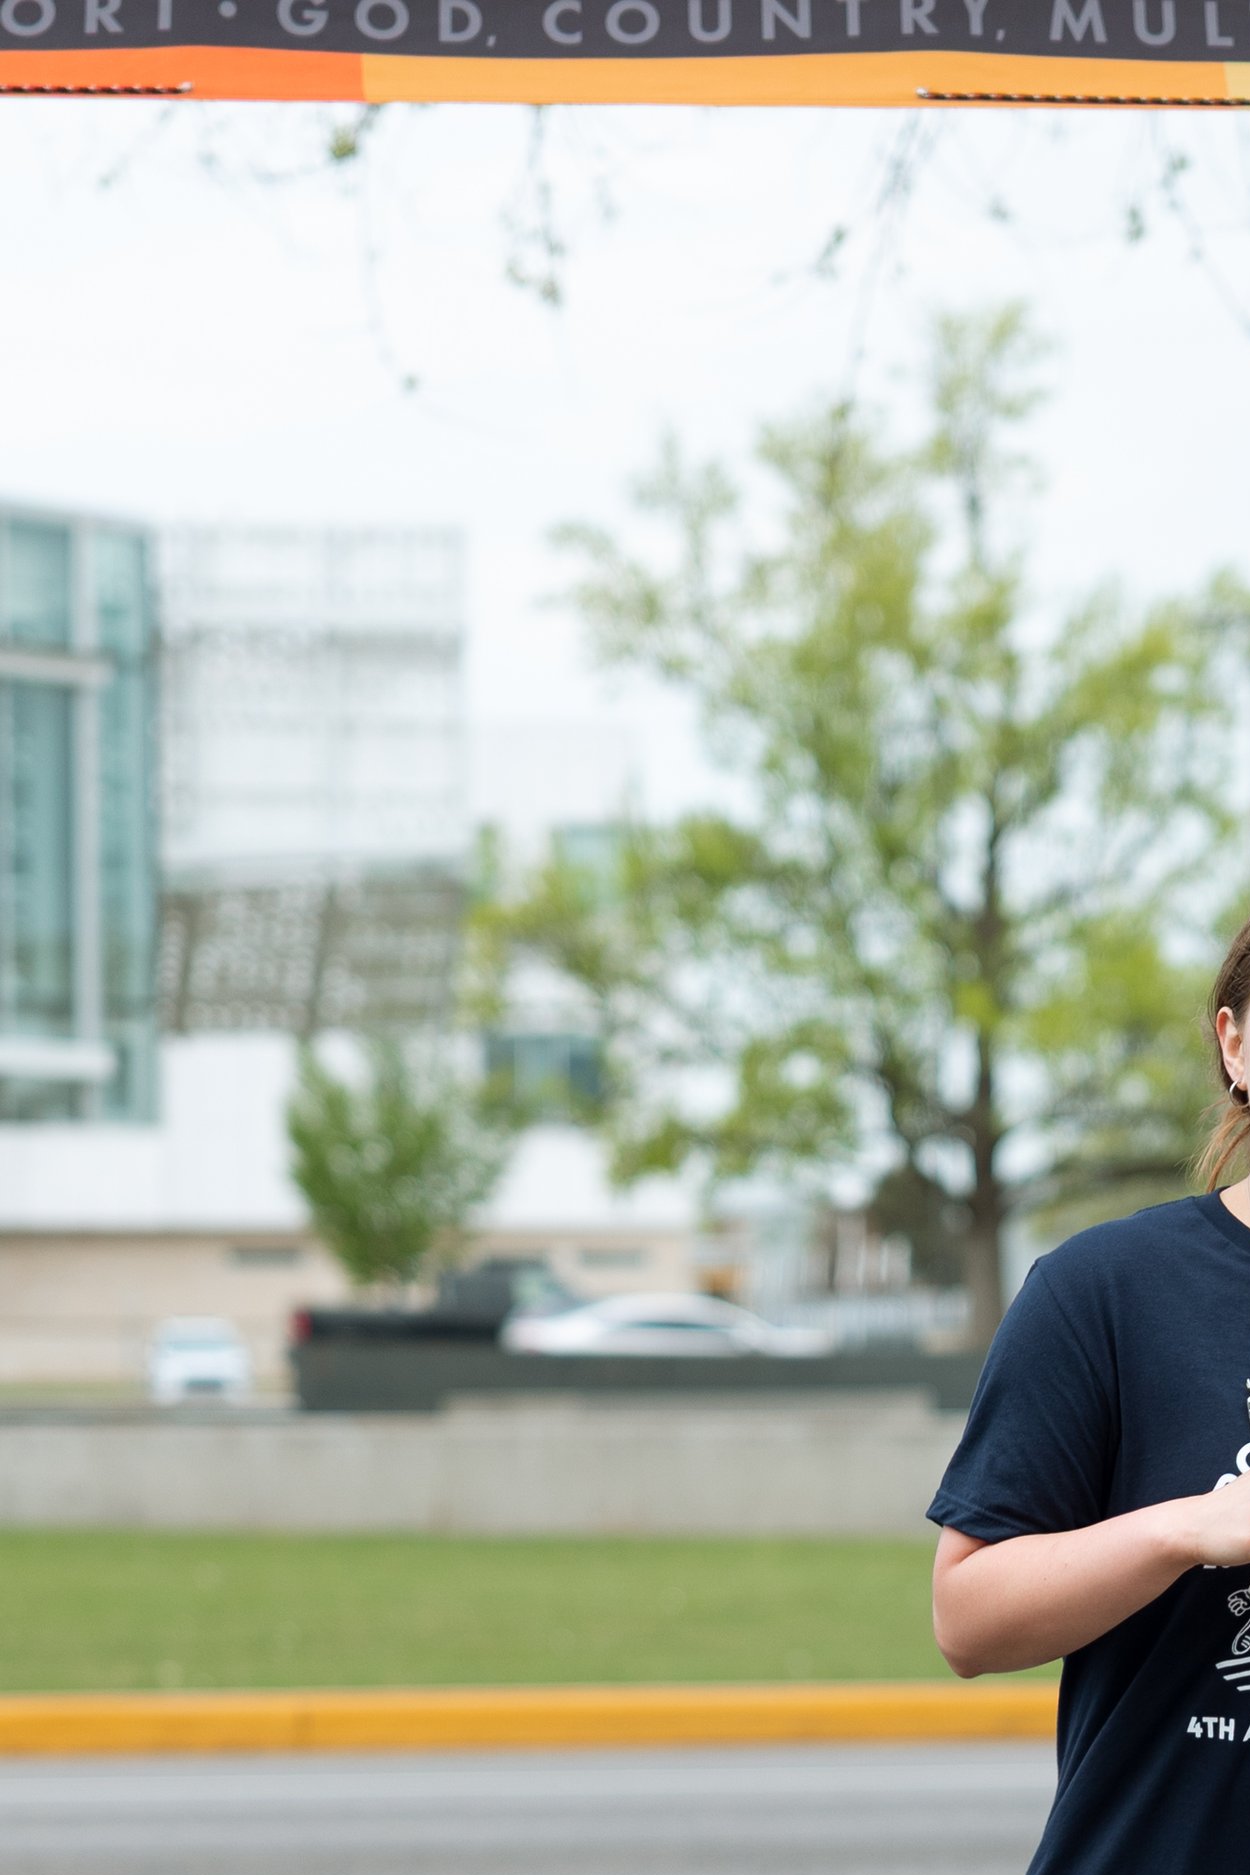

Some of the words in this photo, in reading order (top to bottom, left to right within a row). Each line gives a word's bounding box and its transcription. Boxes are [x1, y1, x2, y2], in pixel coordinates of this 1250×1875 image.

[277, 0, 497, 47] GOD,
[542, 0, 1005, 44] COUNTRY,
[1186, 1716, 1235, 1741] 4TH
